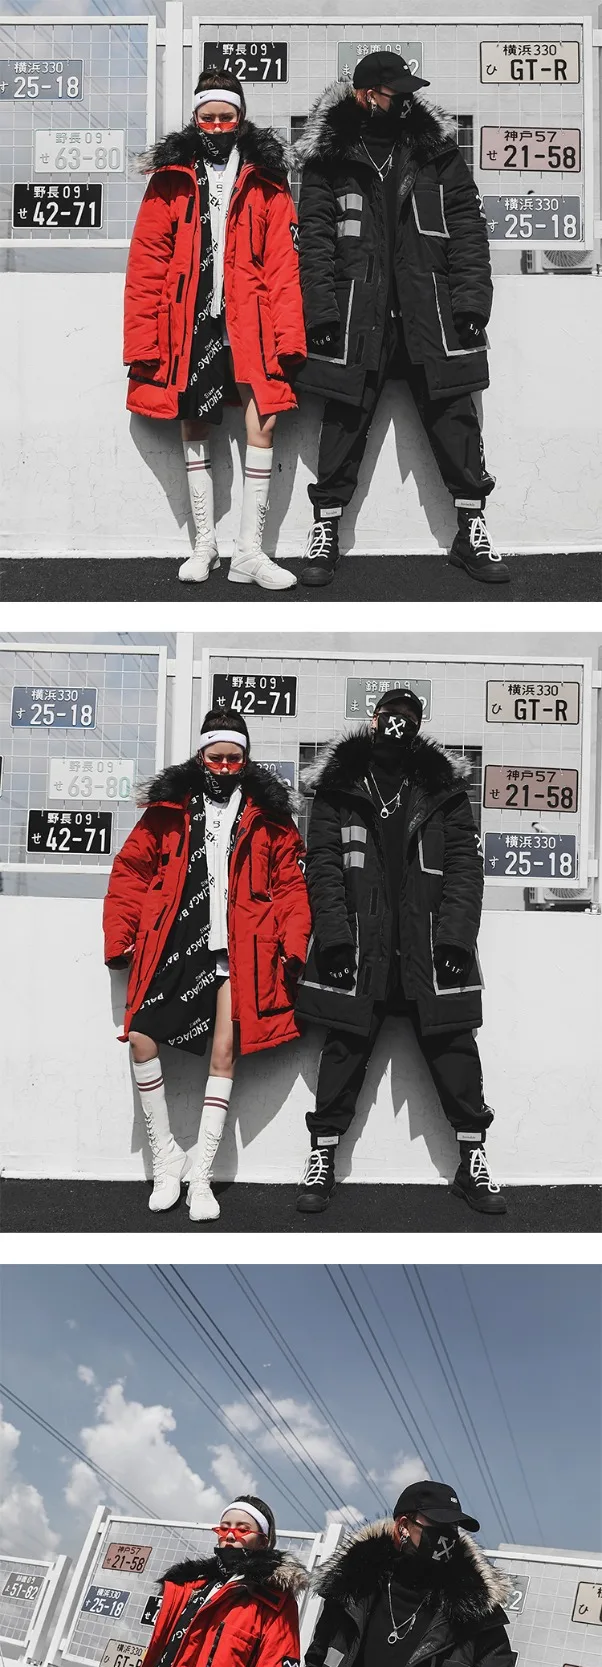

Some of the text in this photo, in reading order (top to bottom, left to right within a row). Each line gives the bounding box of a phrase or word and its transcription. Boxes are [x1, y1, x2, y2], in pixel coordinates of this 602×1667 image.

[502, 44, 557, 56] 横浜330
[14, 61, 64, 74] 横浜330
[486, 58, 568, 81] ひ GT-R
[13, 76, 79, 98] 25-18
[504, 130, 557, 143] 神戸57
[40, 147, 121, 170] せ 63-80
[486, 145, 576, 169] せ 21-58
[17, 201, 96, 226] せ 42-71
[504, 198, 559, 211] 横浜330
[488, 214, 577, 239] す 25-18
[31, 689, 78, 701] 横浜330
[507, 684, 559, 697] 横浜330
[216, 690, 291, 714] せ 42-71
[491, 698, 568, 722] ひ GT-R
[16, 703, 93, 726] す 25-18
[54, 776, 131, 798] せ 63-80
[506, 769, 556, 783] 神戸57
[489, 783, 574, 809] せ 21-58
[31, 826, 106, 852] せ 42-71
[505, 834, 556, 849] 横浜330
[488, 850, 573, 877] す 25-18
[111, 1555, 145, 1571] 21-58
[10, 1581, 39, 1600] 51-82
[90, 1598, 124, 1617] 25-18
[578, 1603, 589, 1615] ひ
